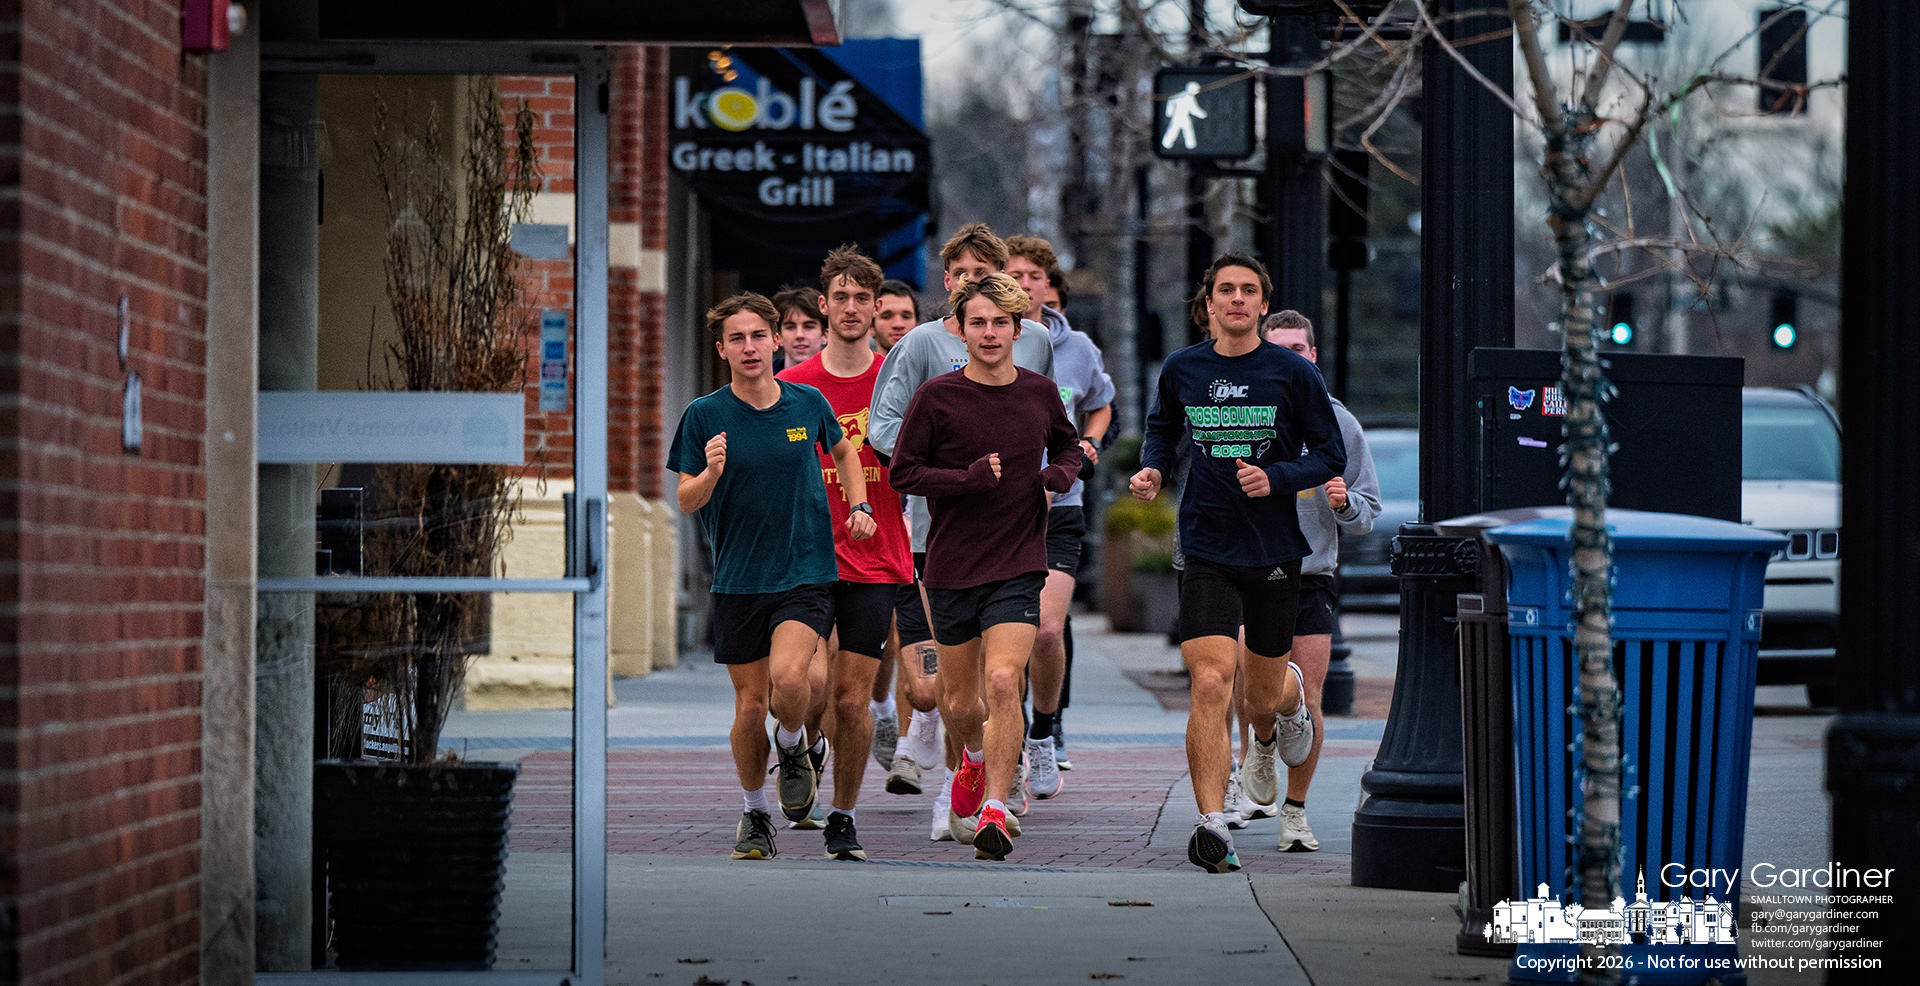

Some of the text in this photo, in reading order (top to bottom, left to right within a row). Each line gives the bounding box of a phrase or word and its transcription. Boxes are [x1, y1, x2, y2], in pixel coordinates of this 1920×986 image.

[672, 141, 916, 172] Greek - Italian
[758, 176, 835, 206] Grill
[1215, 385, 1249, 399] OAC
[1221, 406, 1277, 427] COUNTRY
[788, 432, 808, 442] 1994
[1211, 444, 1252, 458] 2025
